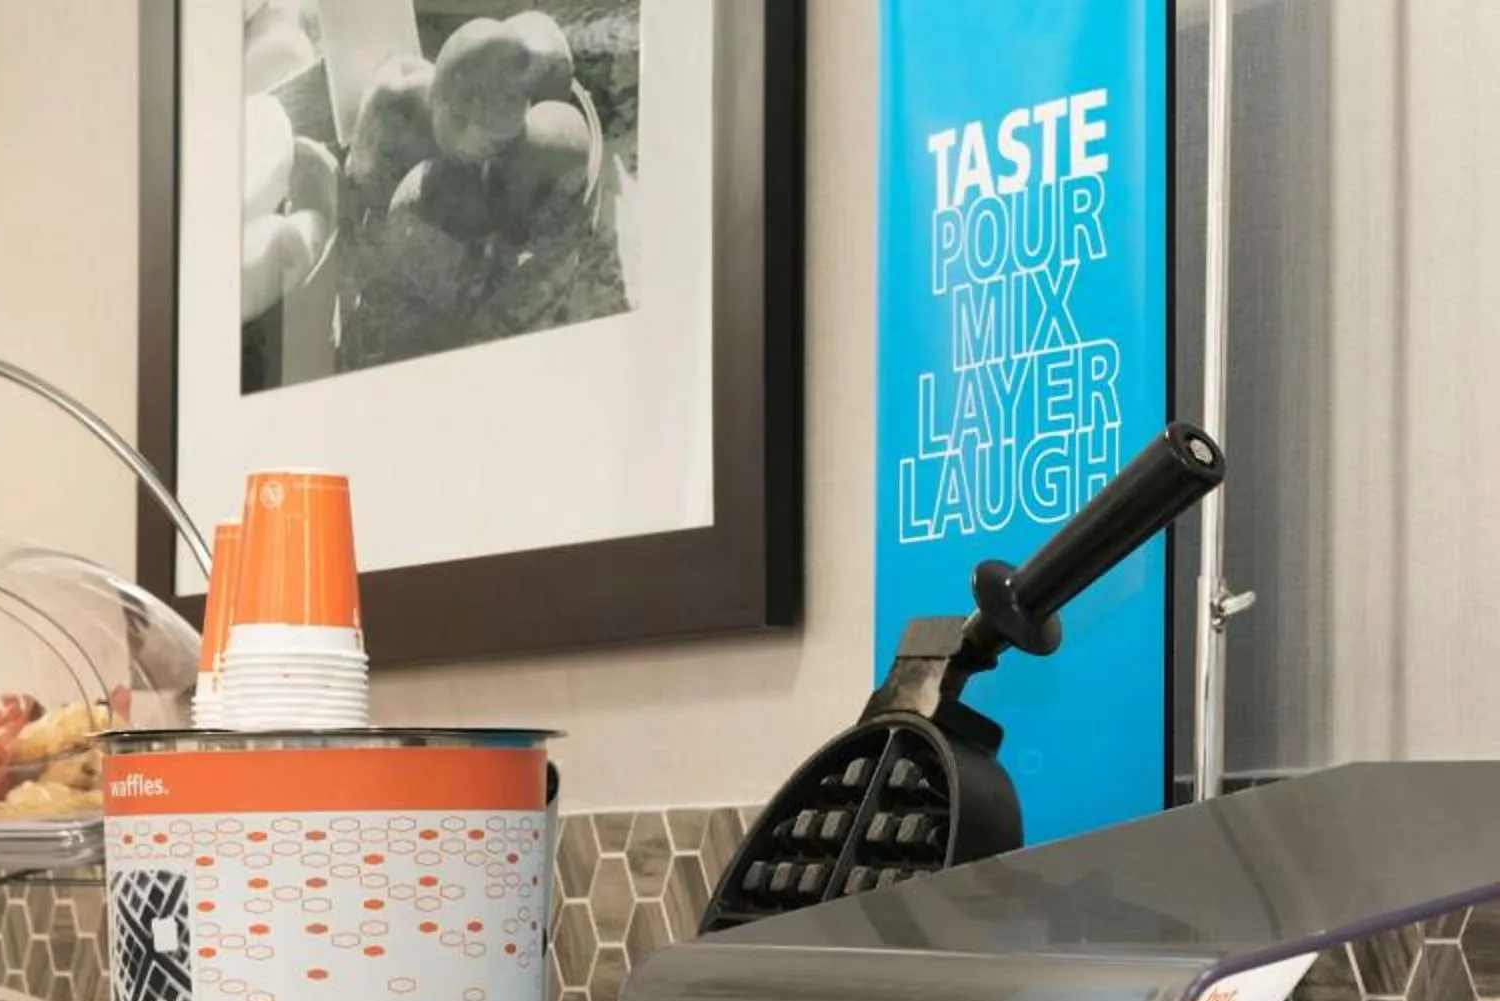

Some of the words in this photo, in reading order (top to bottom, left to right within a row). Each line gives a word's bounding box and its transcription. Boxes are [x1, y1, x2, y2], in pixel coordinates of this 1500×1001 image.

[928, 88, 1109, 213] TASTE
[932, 172, 1107, 295] POUR
[953, 258, 1081, 372] MIX
[918, 338, 1122, 460] LAYER
[900, 423, 1120, 544] LAUGH
